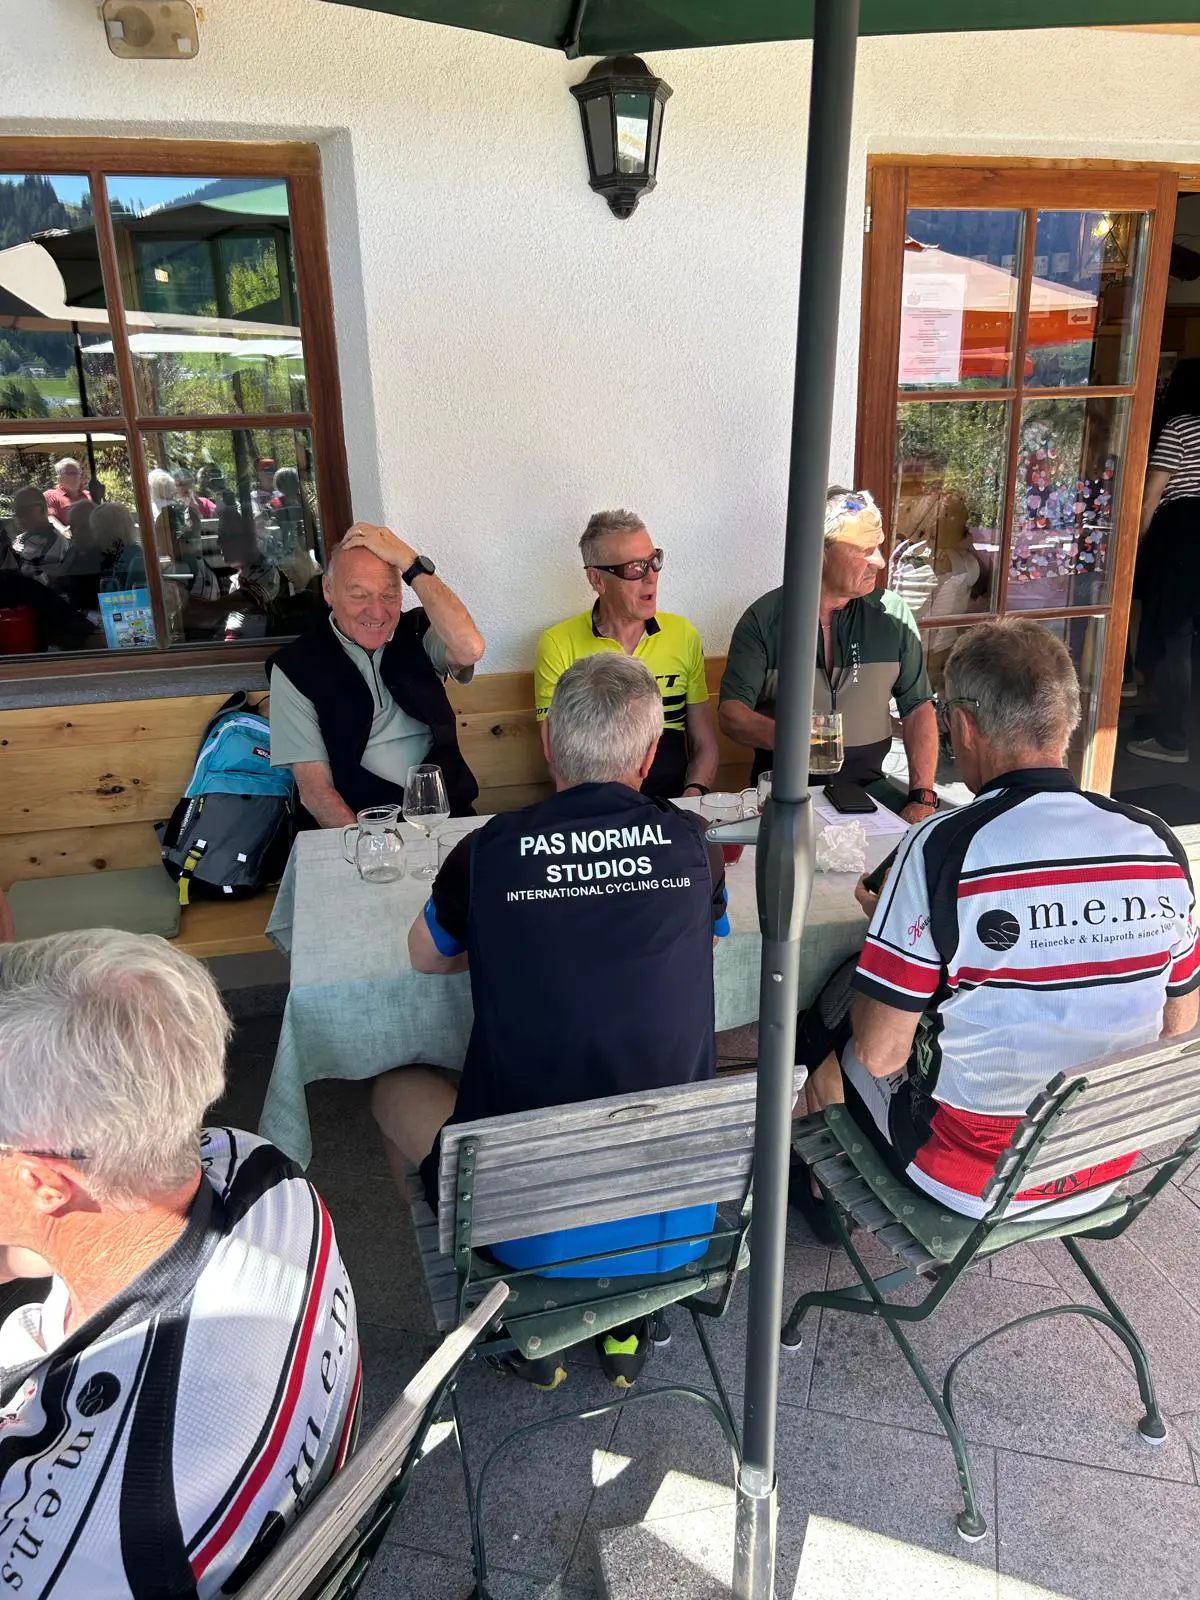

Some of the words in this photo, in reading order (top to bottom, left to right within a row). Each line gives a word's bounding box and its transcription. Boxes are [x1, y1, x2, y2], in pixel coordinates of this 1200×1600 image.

[520, 832, 565, 856] PAS
[571, 824, 672, 854] NORMAL
[546, 856, 653, 883] STUDIOS
[506, 885, 604, 902] INTERNATIONAL
[605, 879, 659, 894] CYCLING
[661, 877, 691, 889] CLUB
[1027, 895, 1185, 930] m.e.n.s.
[1030, 936, 1075, 949] Heinecke
[1079, 935, 1088, 944] &
[1092, 931, 1135, 945] Klaproth
[1138, 929, 1159, 939] since
